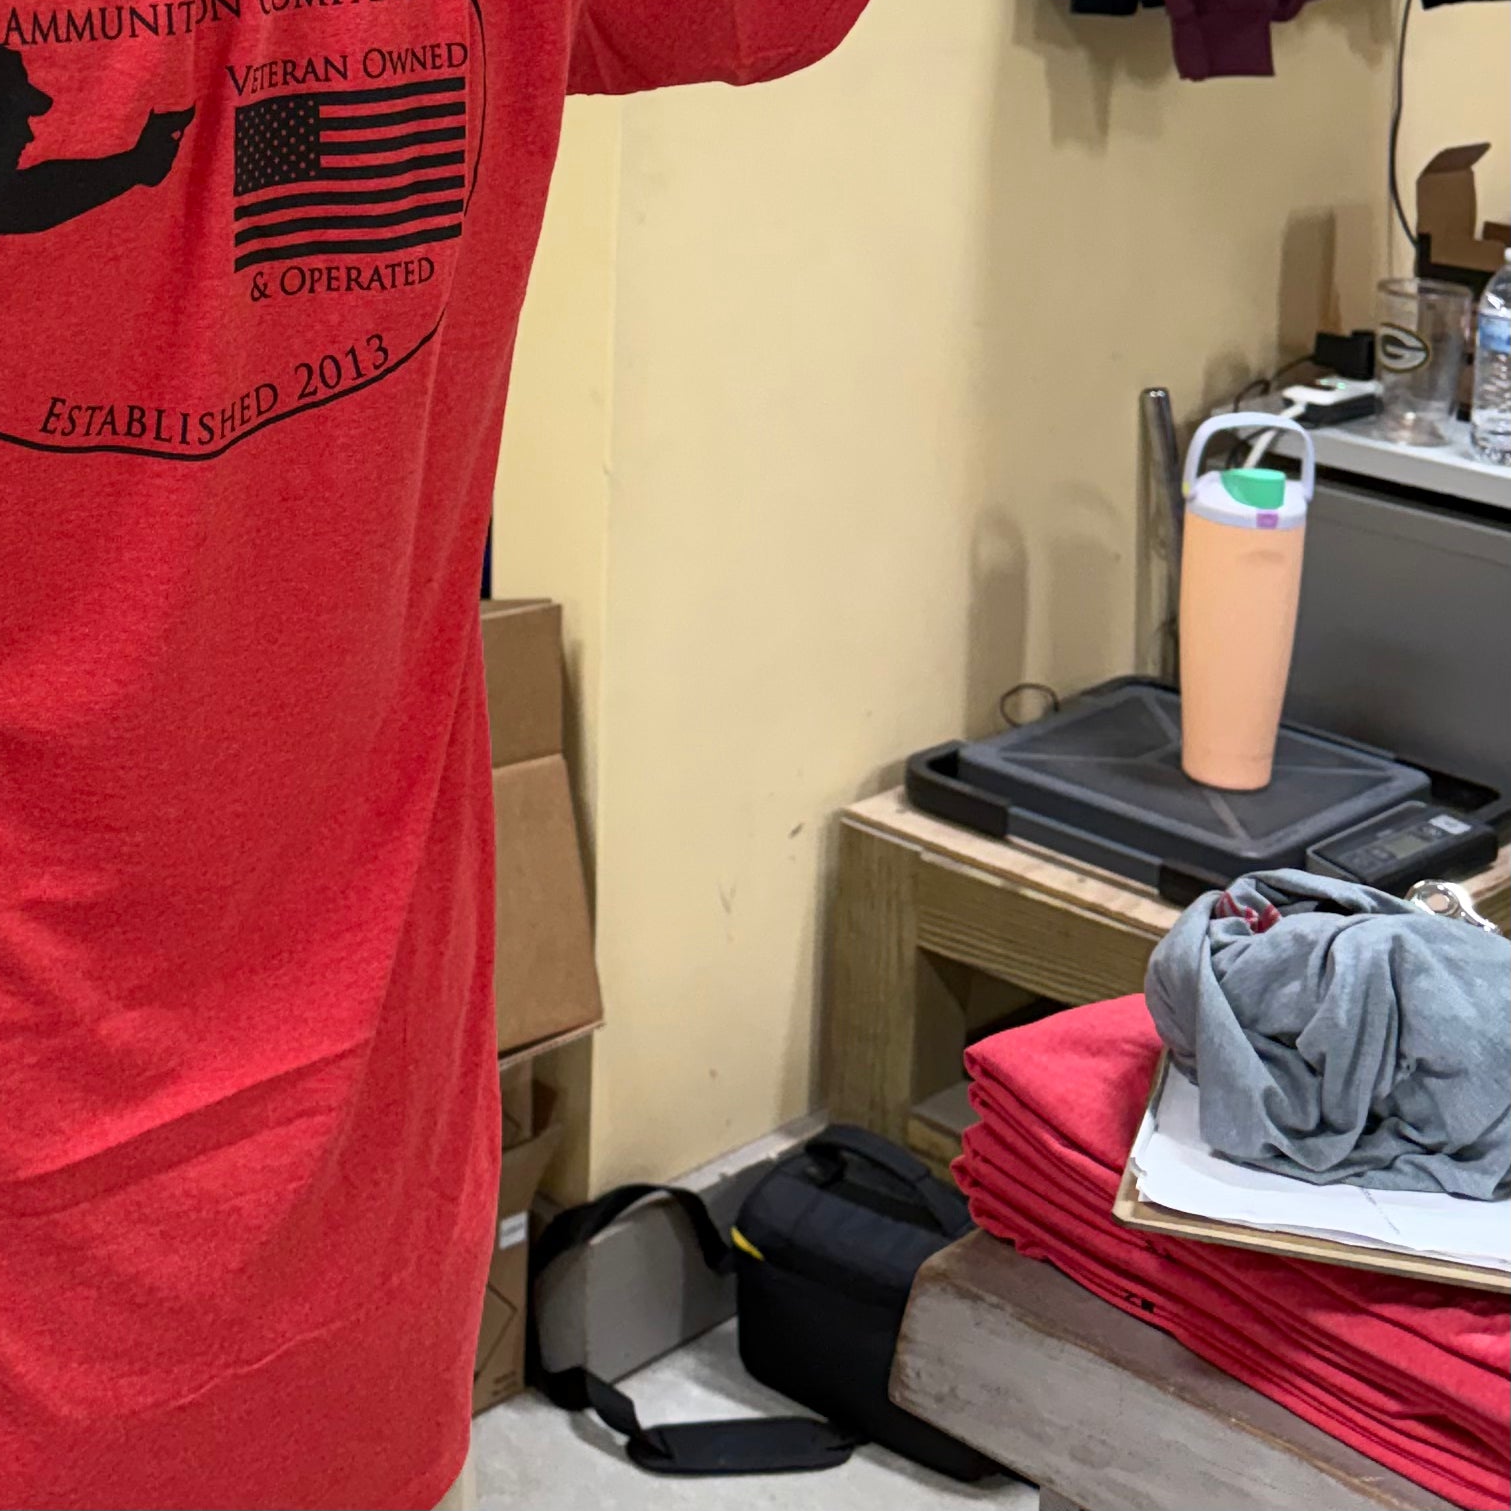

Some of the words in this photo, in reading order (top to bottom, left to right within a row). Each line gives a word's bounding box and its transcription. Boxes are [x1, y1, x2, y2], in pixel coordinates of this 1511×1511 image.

[225, 54, 349, 96] VETERAN
[362, 42, 469, 80] OWNED
[250, 271, 272, 303] &
[279, 257, 435, 296] OPERATED
[39, 382, 279, 447] ESTABLISHED
[294, 333, 390, 402] 2013
